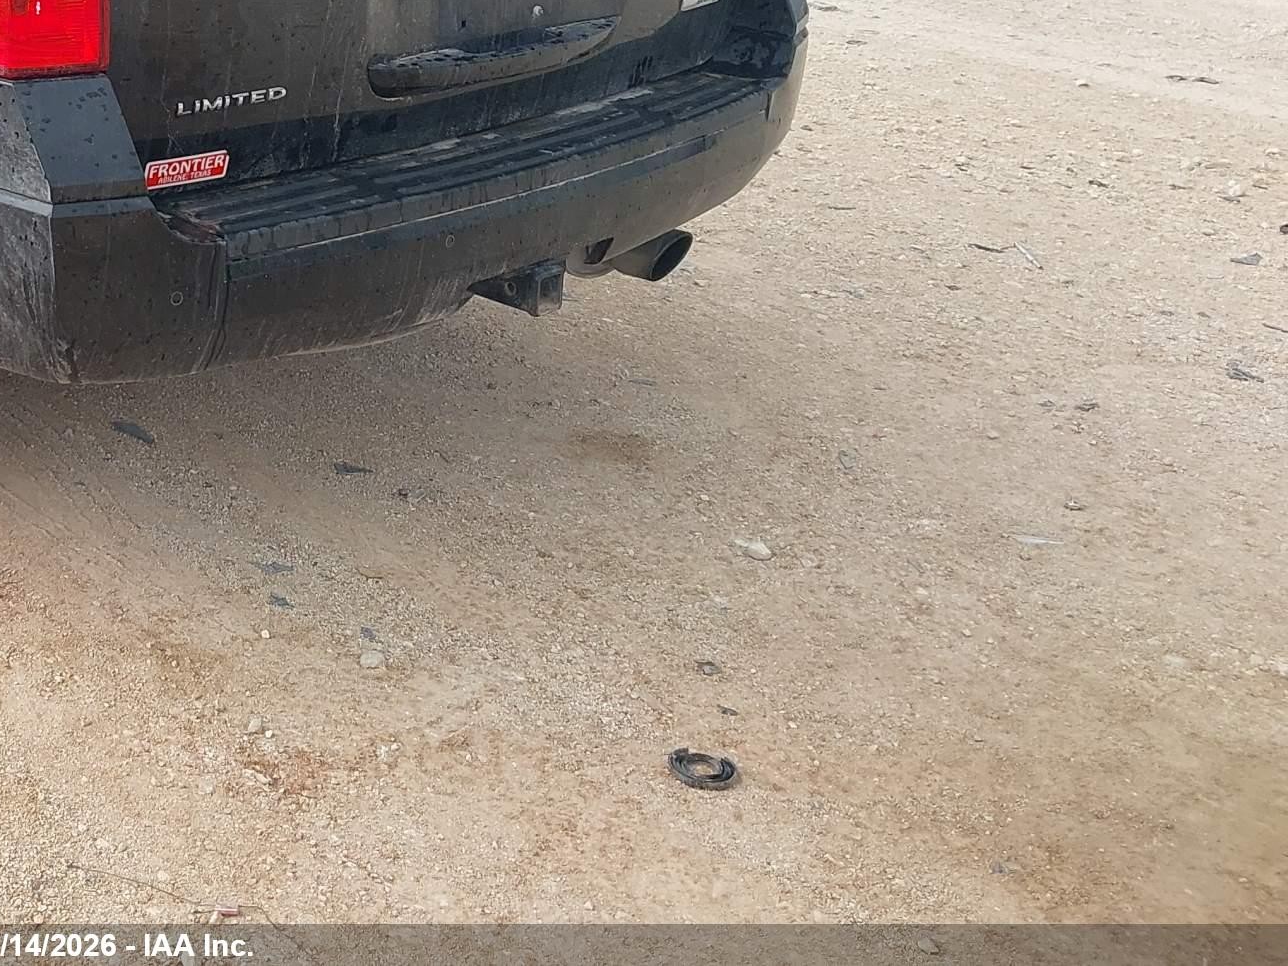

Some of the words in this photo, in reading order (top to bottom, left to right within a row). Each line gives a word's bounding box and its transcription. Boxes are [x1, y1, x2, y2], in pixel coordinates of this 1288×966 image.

[177, 87, 287, 115] LIMITED
[149, 155, 224, 179] FRONTIER
[190, 169, 212, 180] TEXAS
